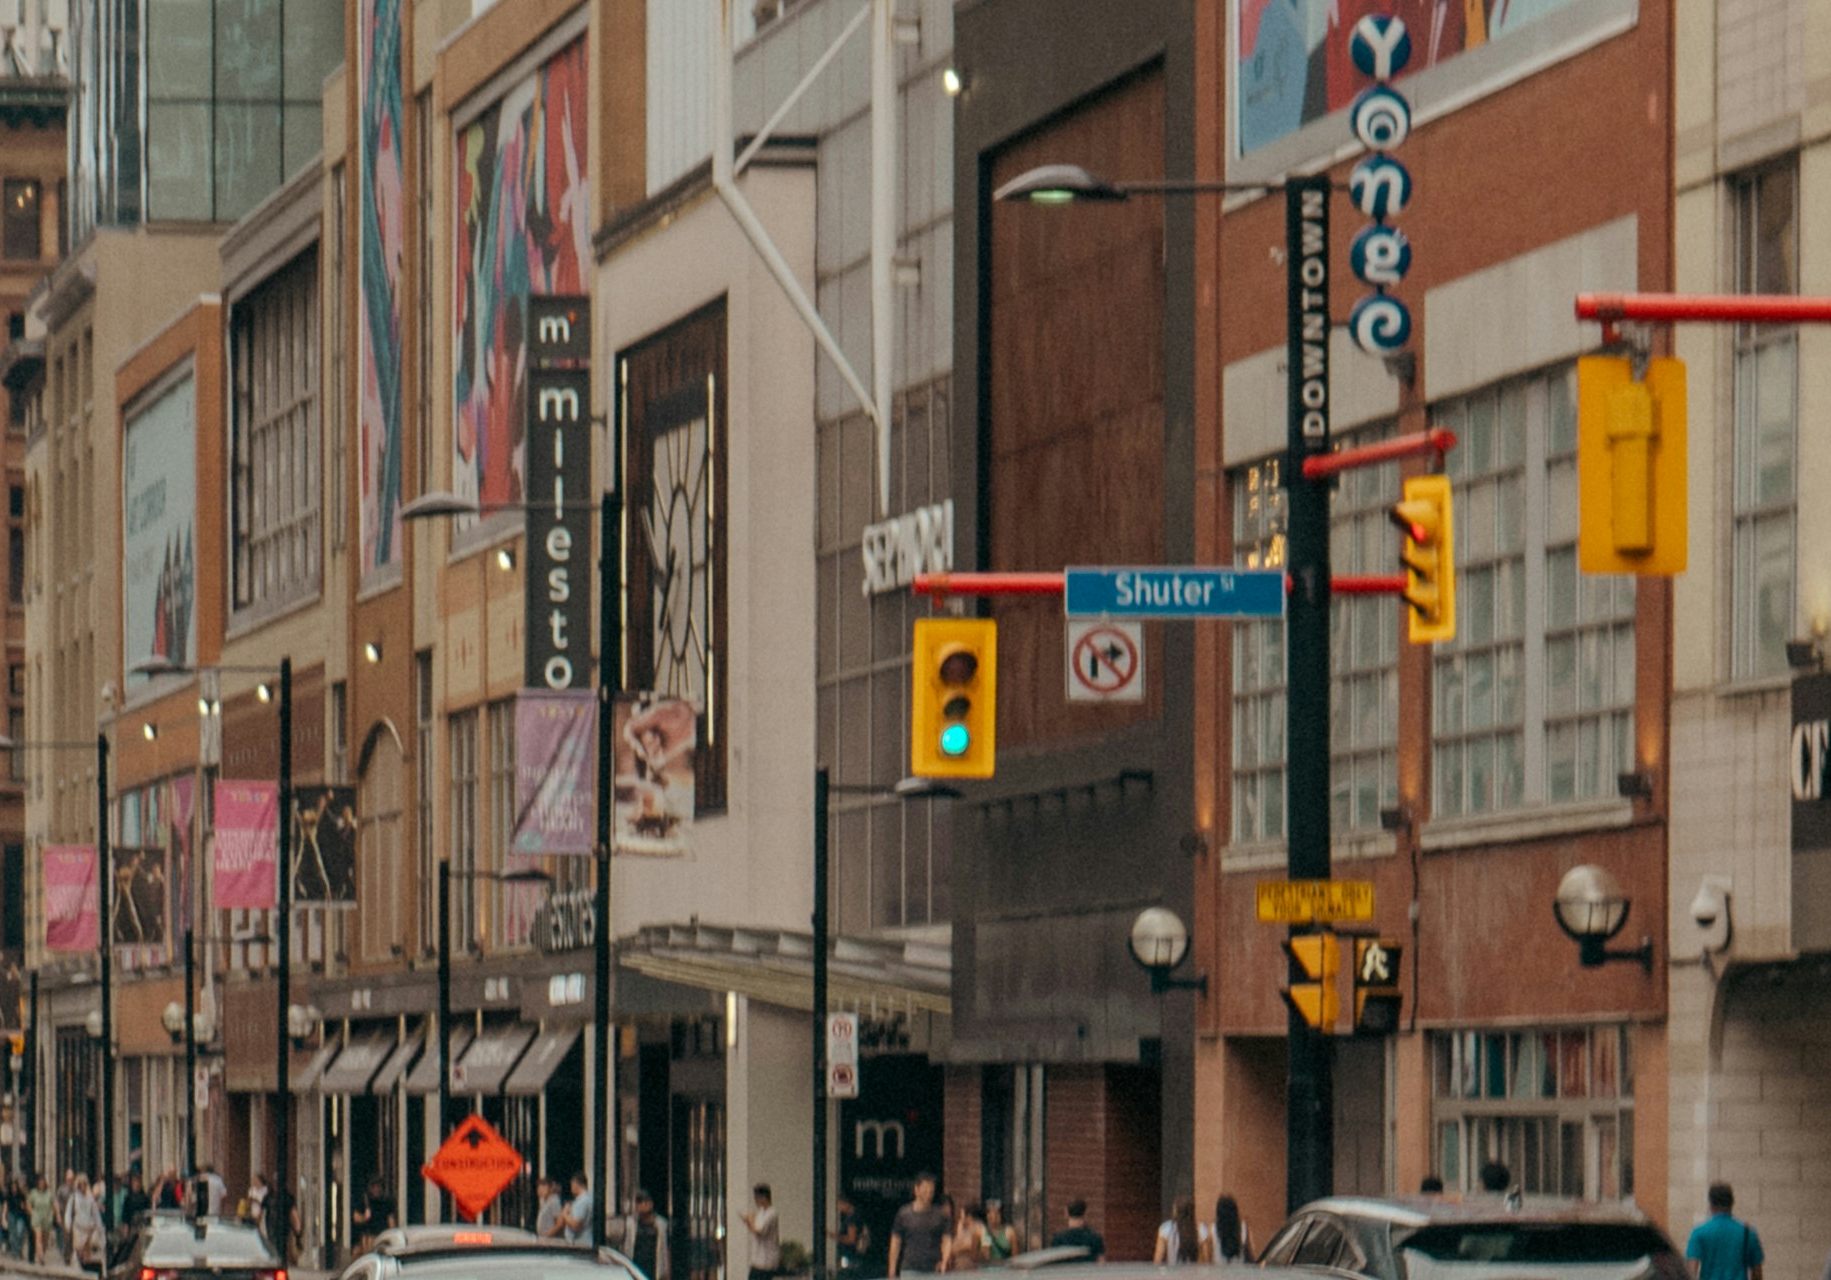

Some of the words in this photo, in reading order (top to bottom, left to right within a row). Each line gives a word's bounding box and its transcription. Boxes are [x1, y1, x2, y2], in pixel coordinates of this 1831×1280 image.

[1350, 14, 1412, 354] Yonge
[1301, 189, 1327, 437] DOWNTOWN
[1115, 572, 1213, 607] Shuter
[1791, 717, 1830, 800] CF
[855, 1119, 905, 1160] m
